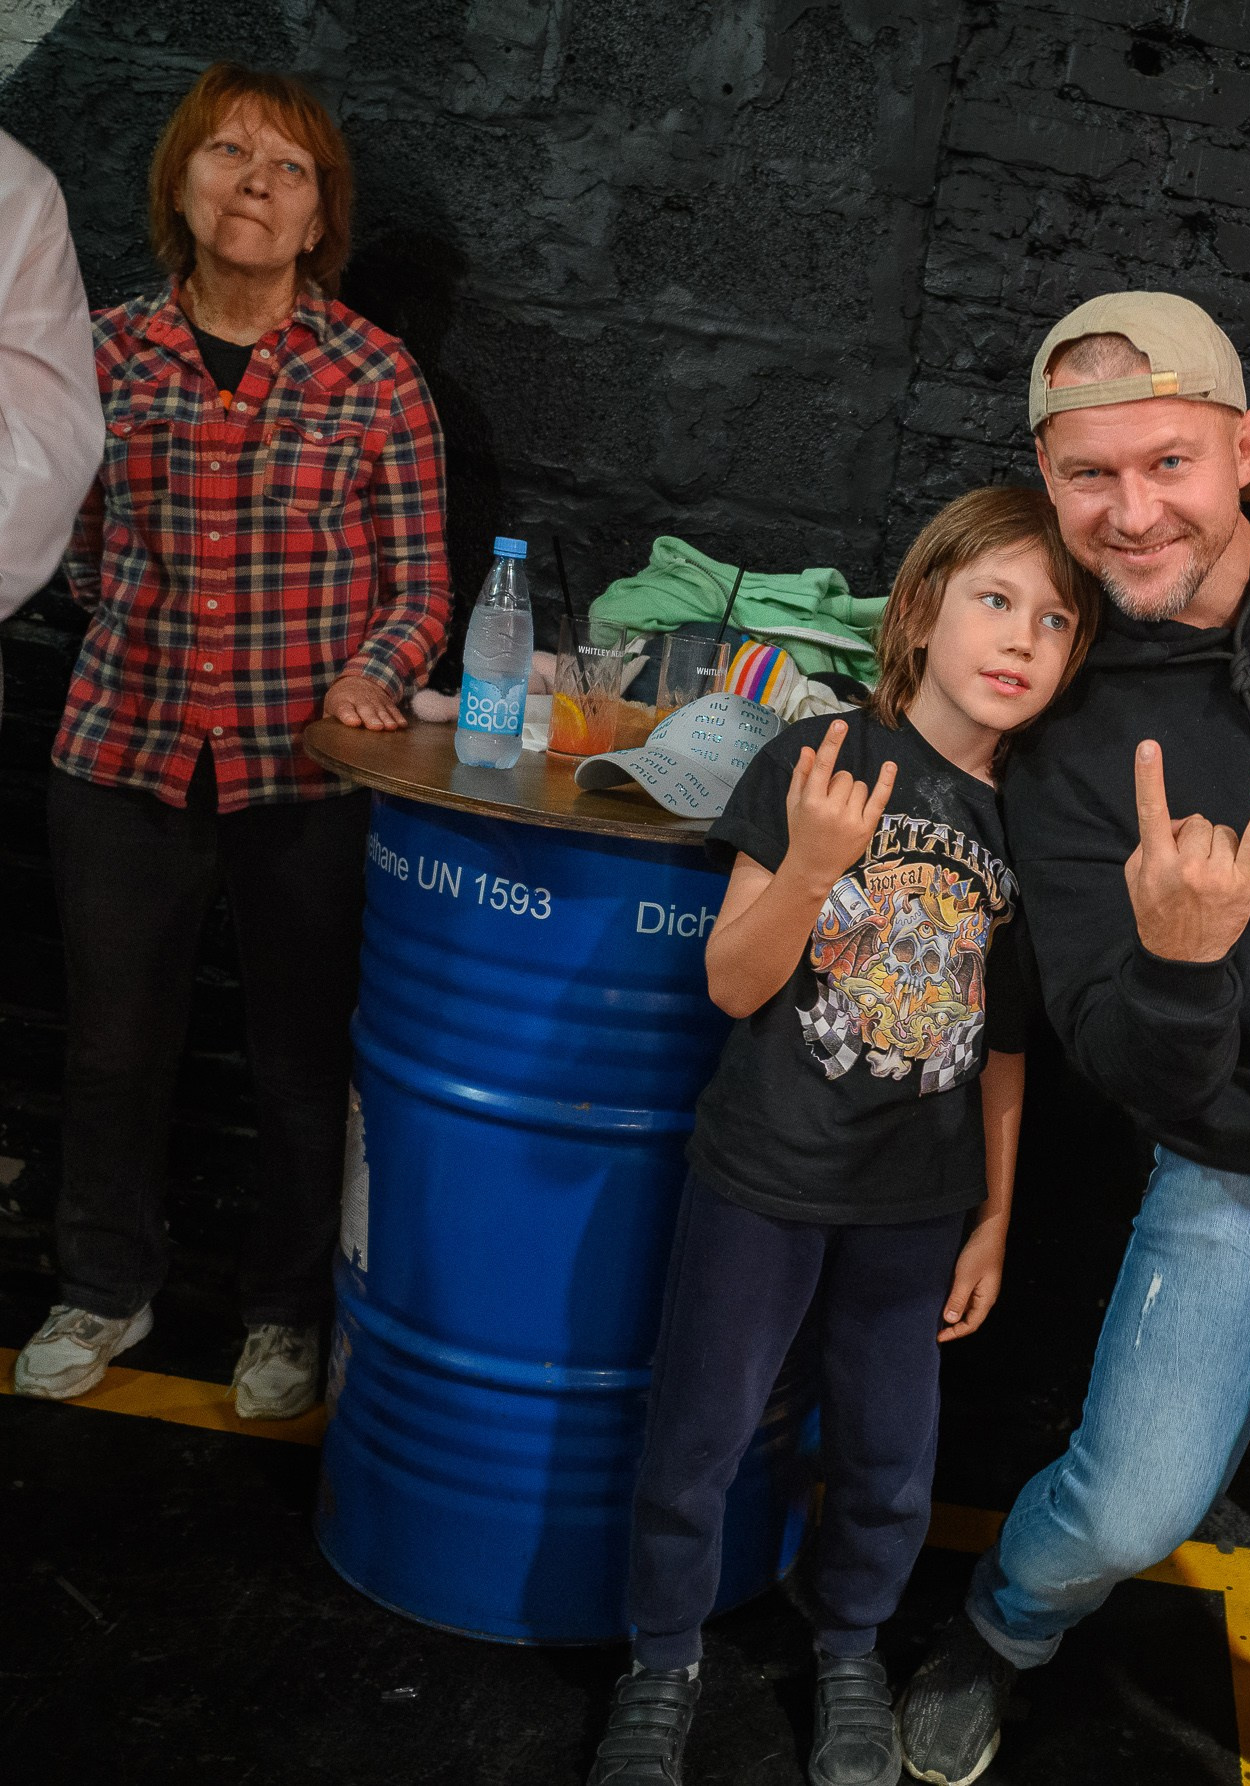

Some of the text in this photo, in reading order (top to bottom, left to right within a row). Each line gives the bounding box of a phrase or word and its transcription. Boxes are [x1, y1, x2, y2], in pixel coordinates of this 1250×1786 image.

[578, 645, 611, 657] WHITLEY
[467, 691, 519, 715] bona
[465, 711, 518, 732] aqua
[694, 714, 725, 727] miu
[691, 730, 723, 743] miu
[629, 762, 657, 785] miu
[685, 772, 710, 797] miu
[675, 782, 699, 808] miu
[859, 813, 1020, 908] ETALLICA
[418, 856, 462, 898] UN
[475, 873, 551, 919] 1593
[870, 866, 922, 891] nor cal
